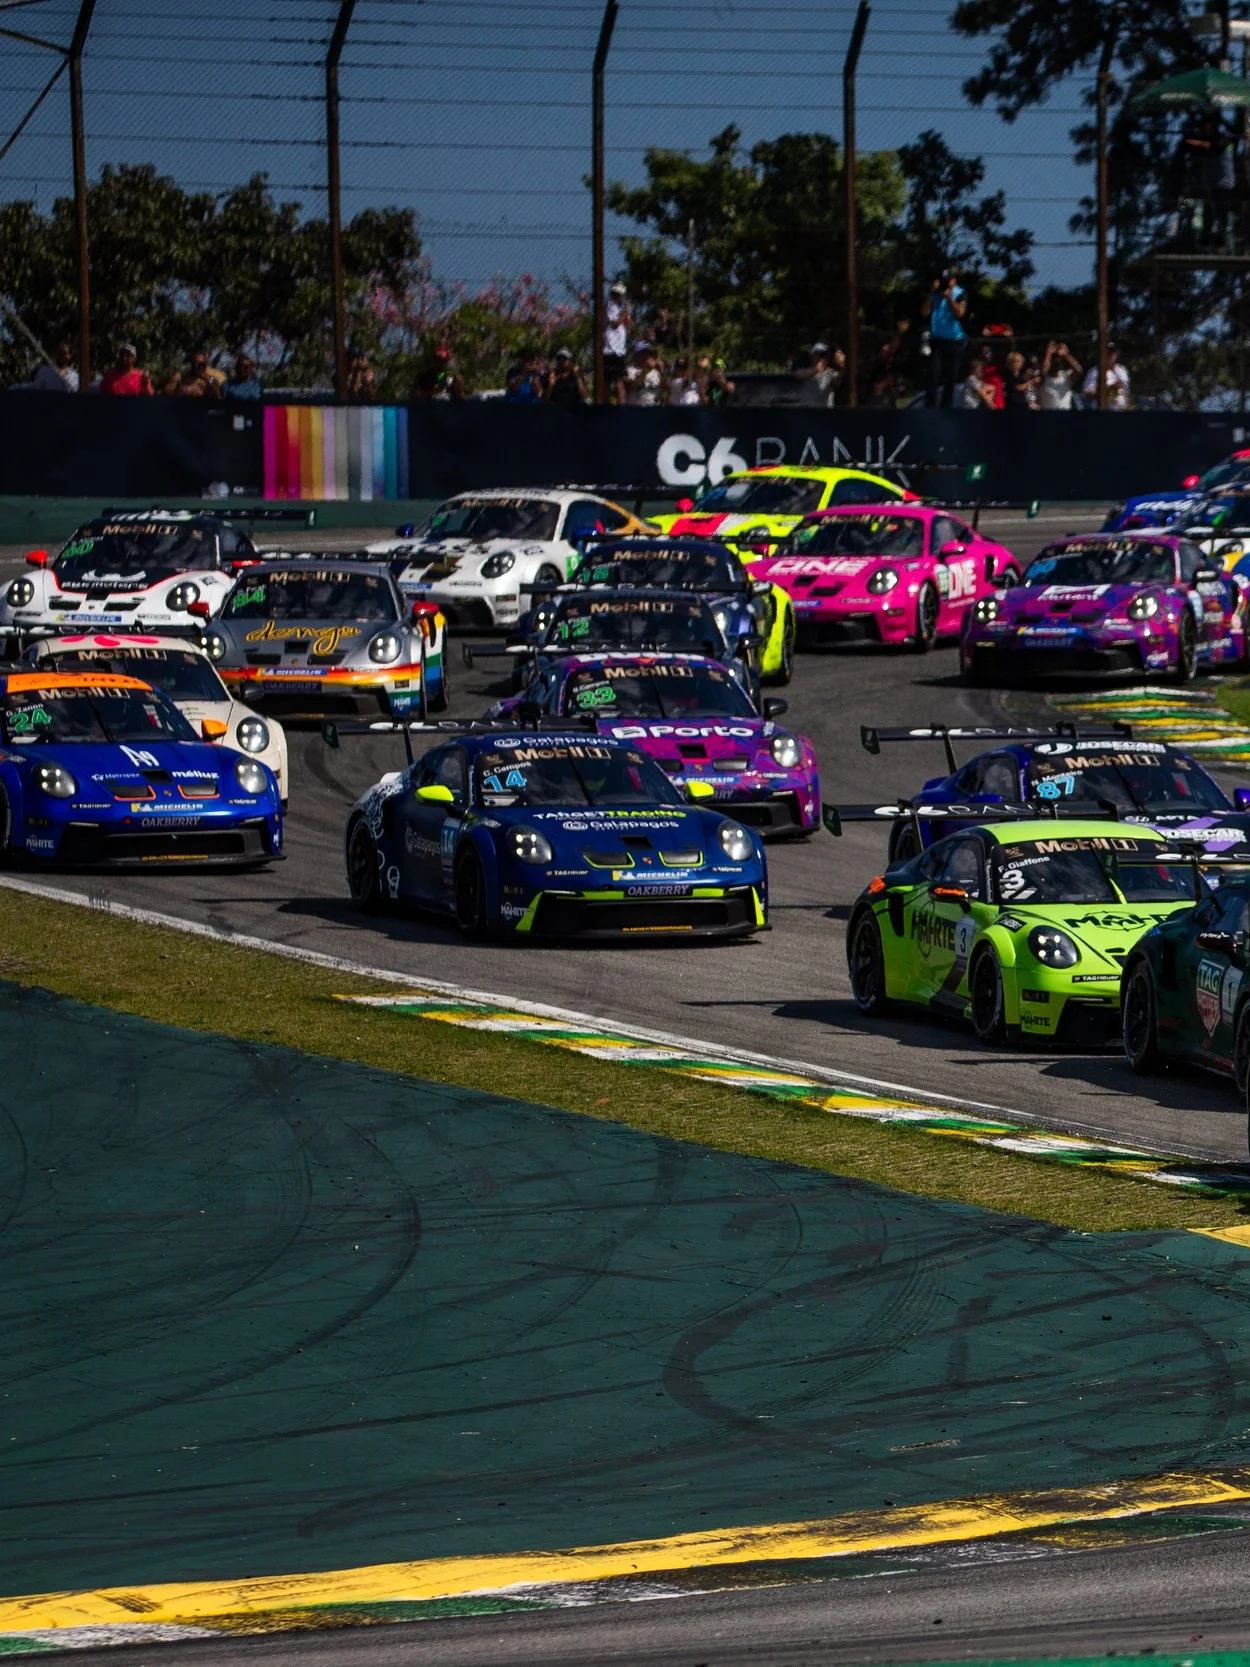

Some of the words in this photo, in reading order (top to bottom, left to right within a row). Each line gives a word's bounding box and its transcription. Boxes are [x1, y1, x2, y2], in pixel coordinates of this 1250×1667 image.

[656, 434, 748, 487] C6
[590, 602, 648, 614] Mobil
[78, 649, 142, 662] Mobil
[604, 666, 667, 679] Mobil
[37, 687, 102, 700] Mobil
[576, 686, 617, 710] 33
[9, 707, 51, 733] 24
[649, 726, 754, 738] Porto
[522, 736, 619, 746] Galapagos
[514, 746, 585, 761] Mobil
[1064, 755, 1134, 770] Mobil
[483, 769, 528, 794] 14
[1036, 776, 1075, 800] 87
[150, 803, 203, 811] MICHELIN
[140, 816, 201, 828] OAKBERRY
[1157, 828, 1247, 841] OSECAR
[1035, 838, 1110, 854] Mobil
[1007, 855, 1050, 869] Giaffone
[1000, 868, 1025, 891] 3
[627, 885, 690, 896] OAKBERRY
[1201, 964, 1220, 990] TAG
